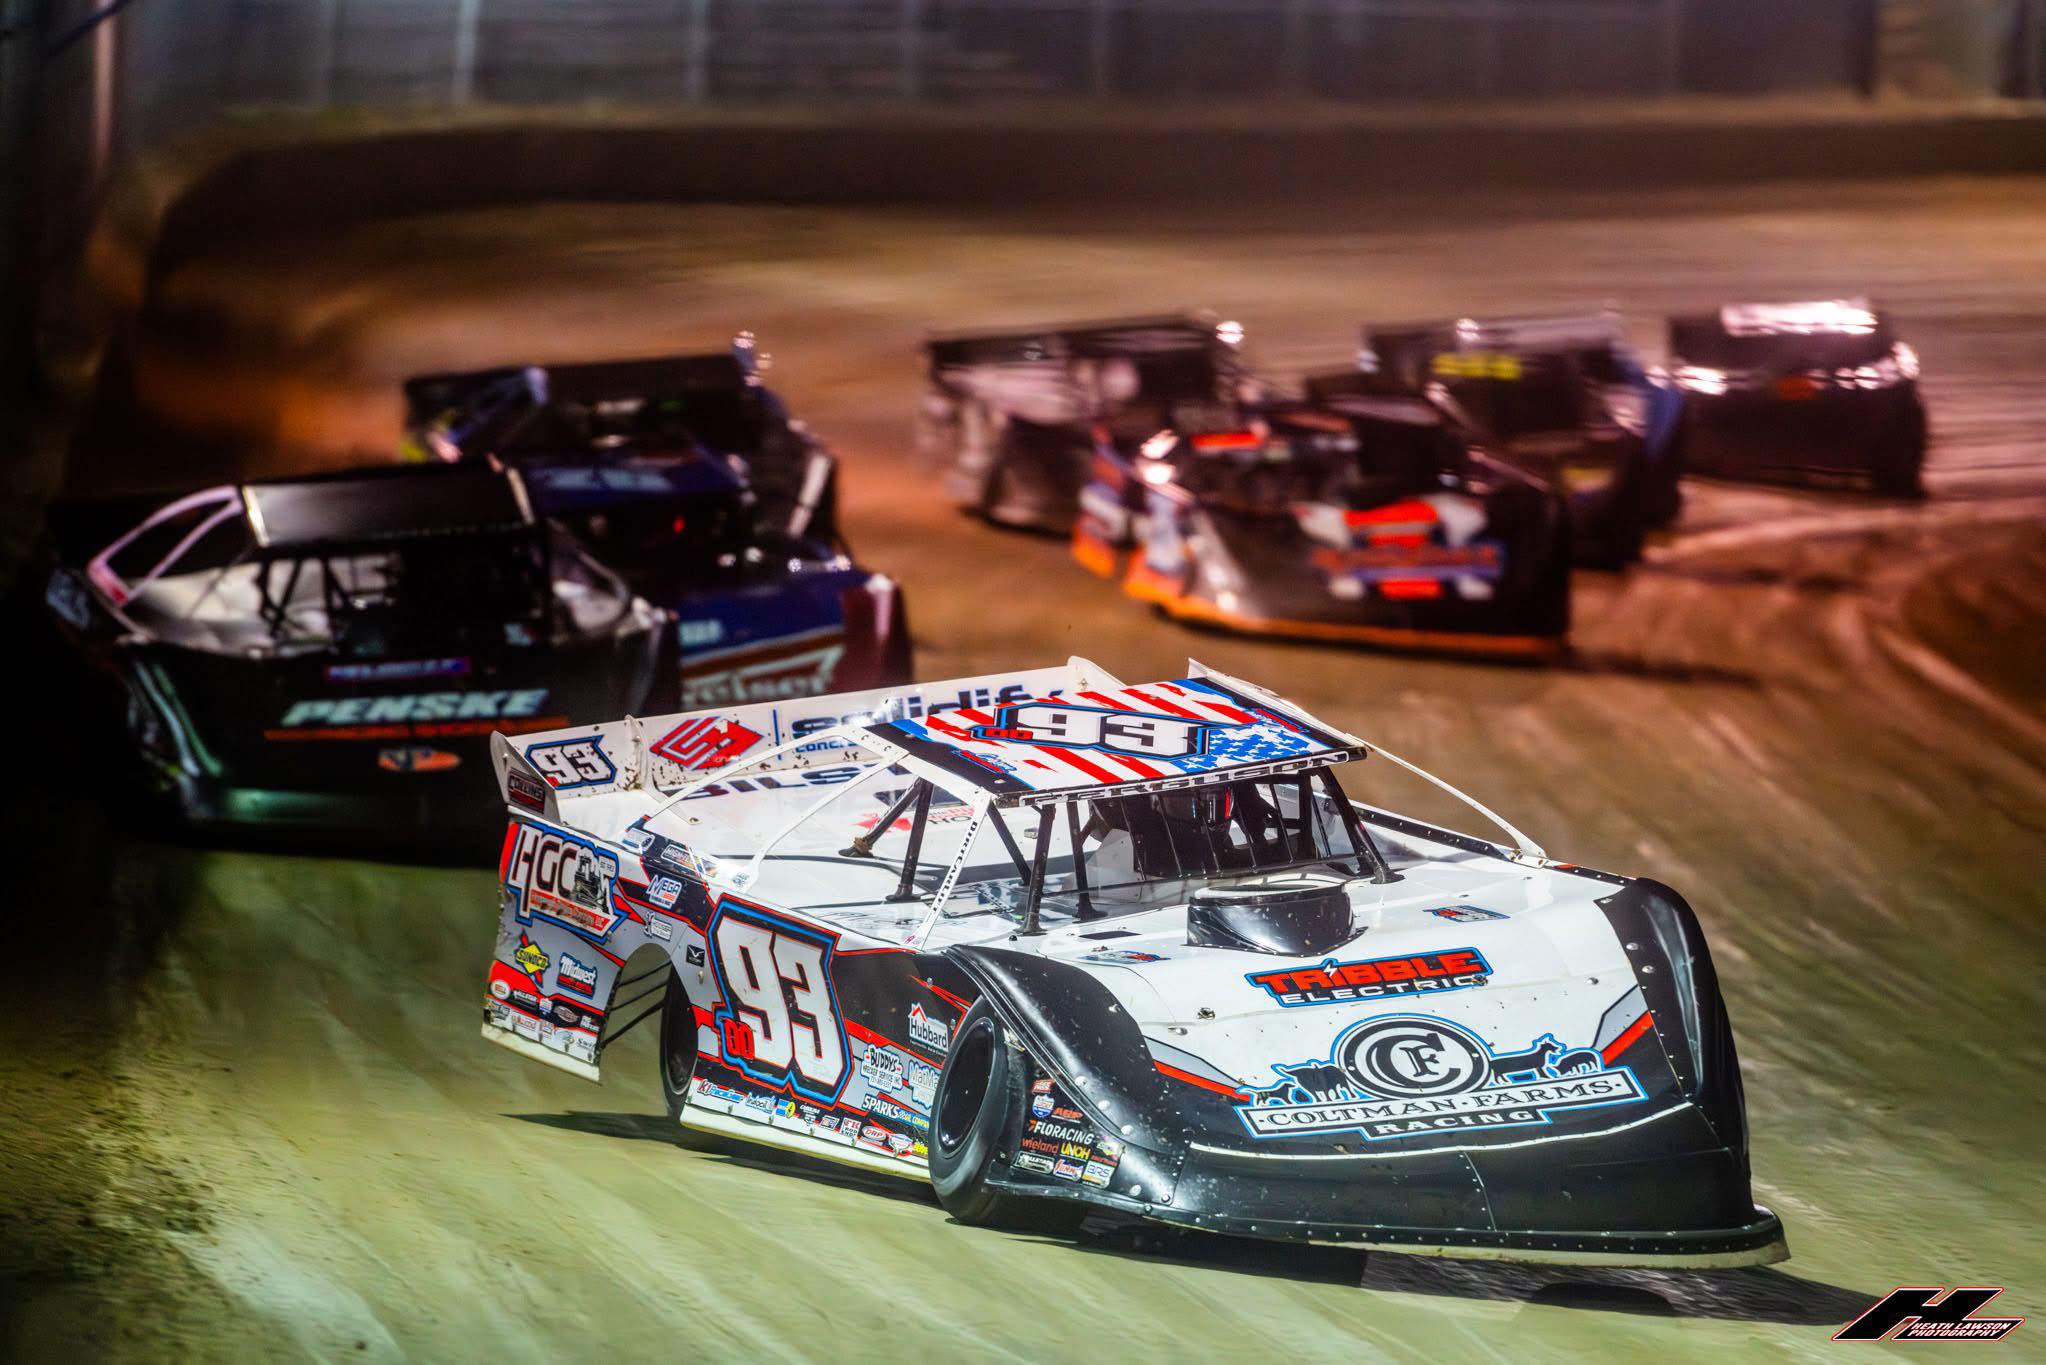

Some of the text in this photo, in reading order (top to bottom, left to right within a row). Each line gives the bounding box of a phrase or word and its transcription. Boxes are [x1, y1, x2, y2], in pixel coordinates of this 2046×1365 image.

[282, 690, 549, 726] PENSKE
[1016, 706, 1190, 757] 93
[531, 746, 613, 787] 93
[1023, 752, 1347, 807] FERGUSON
[647, 874, 681, 897] MEGA
[516, 949, 549, 970] SUNOCO
[560, 955, 597, 986] Midwest
[1257, 951, 1486, 994] TRIBBLE
[716, 915, 845, 1088] 93
[1280, 974, 1486, 1004] ELECTRIC
[909, 1016, 948, 1049] Hubbard
[870, 1047, 898, 1072] BUDDYS
[863, 1096, 900, 1119] SPARKS
[1266, 1081, 1613, 1127] COLTMAN FARMS
[1034, 1121, 1095, 1145] FLORACING
[1376, 1109, 1538, 1137] RACING
[1022, 1138, 1060, 1154] wieland
[1061, 1142, 1091, 1160] UNOH
